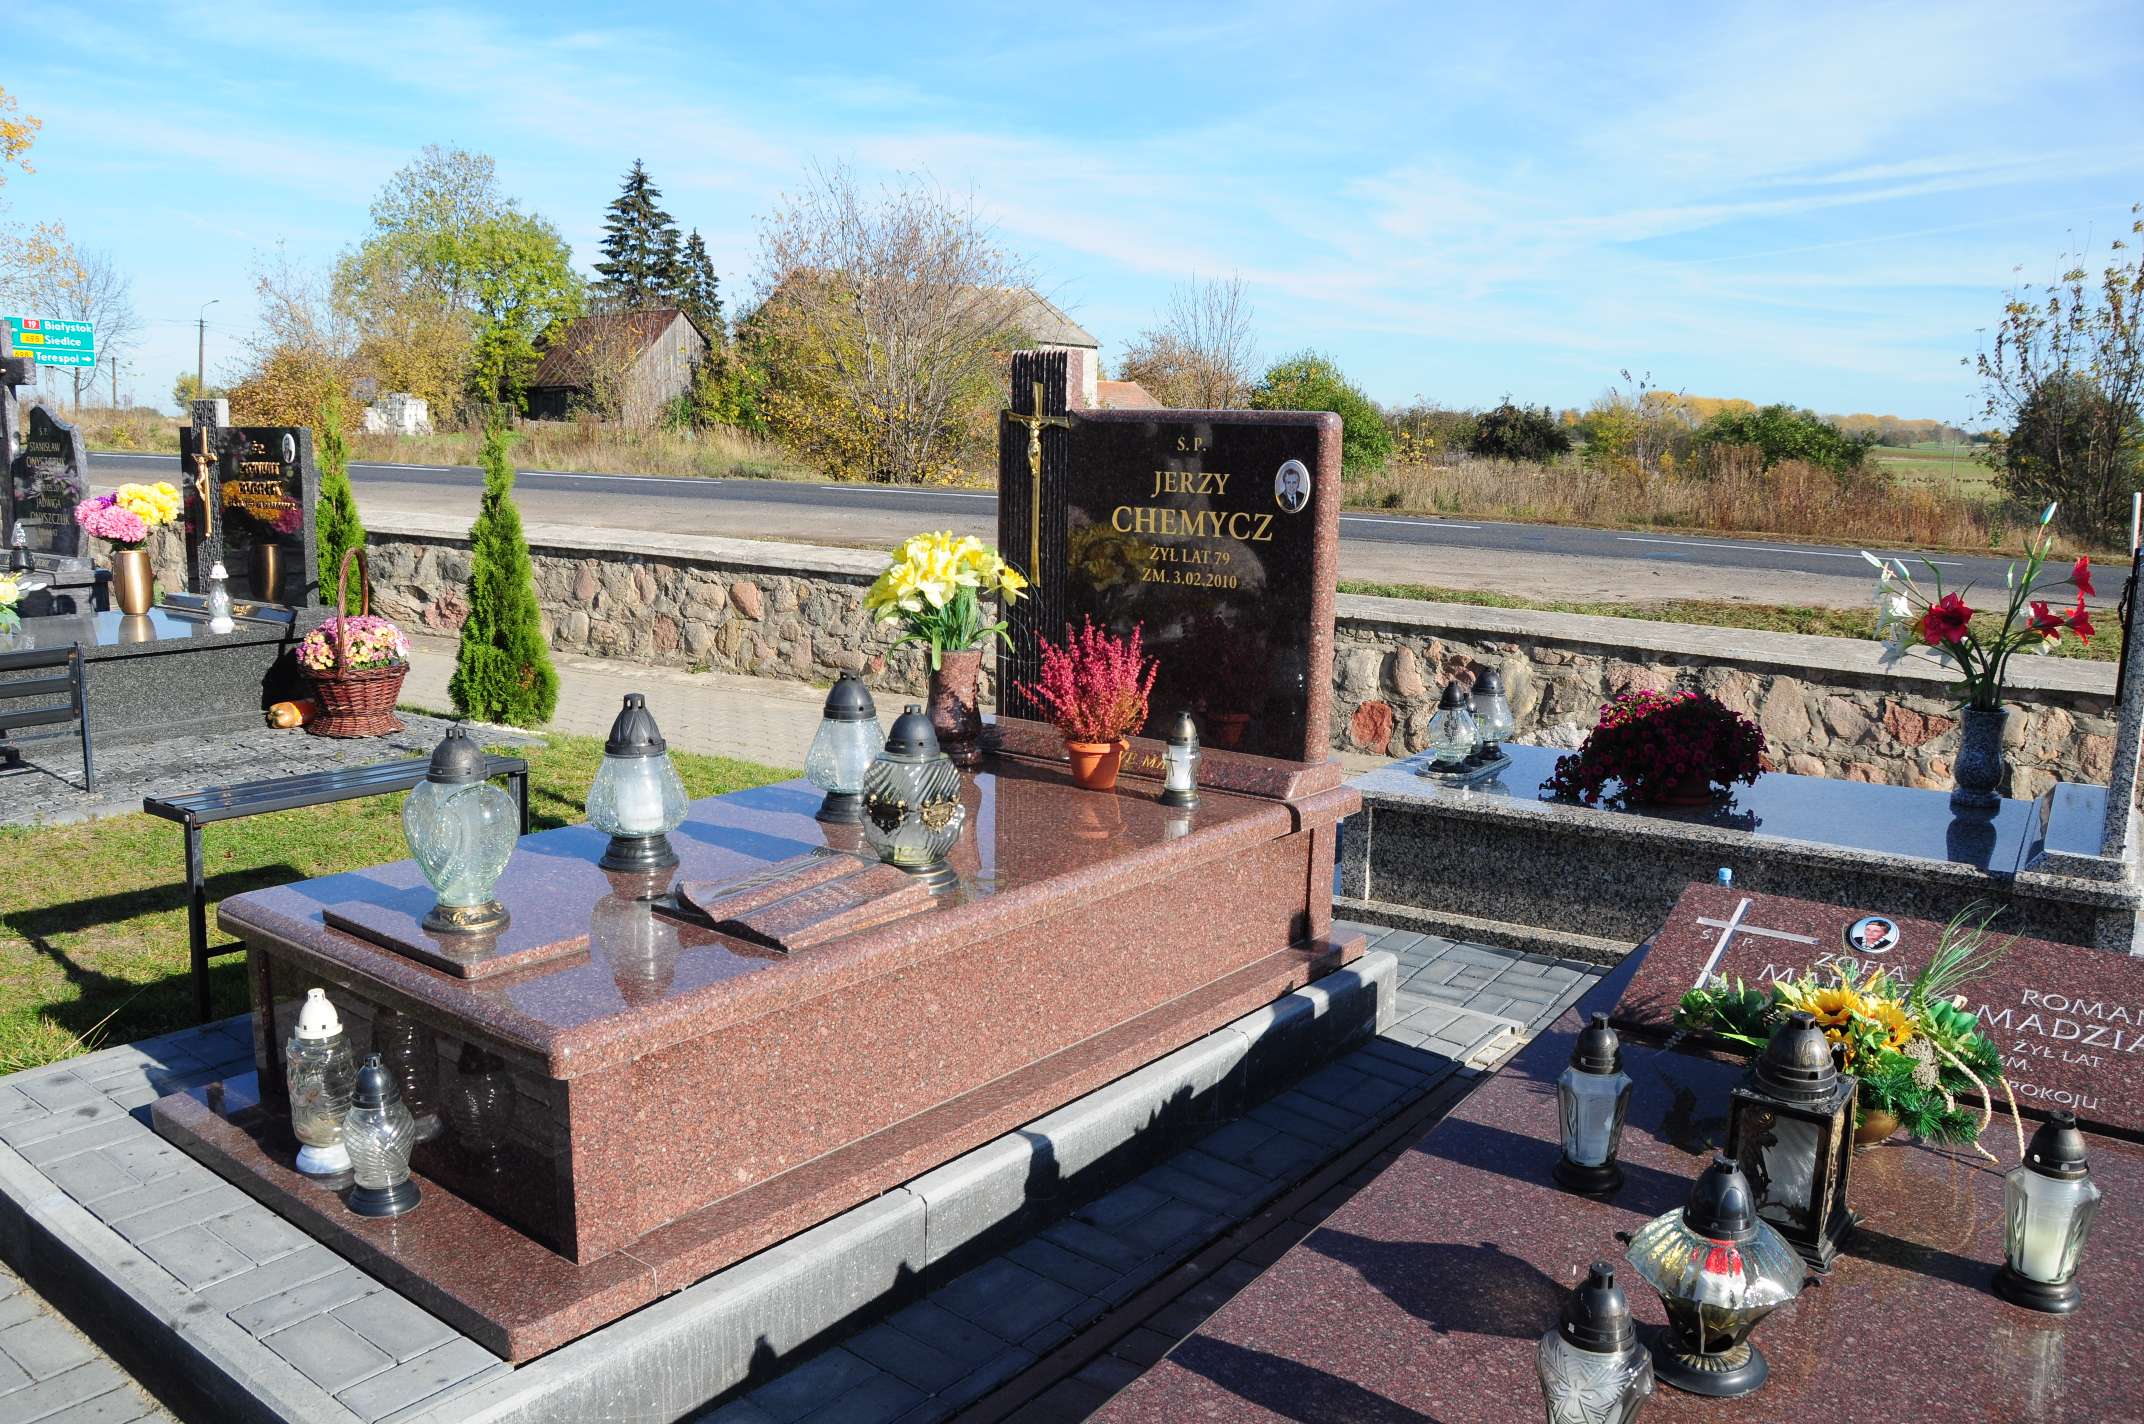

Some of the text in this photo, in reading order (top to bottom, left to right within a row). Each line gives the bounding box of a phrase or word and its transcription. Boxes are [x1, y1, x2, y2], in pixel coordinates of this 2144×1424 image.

[44, 335, 81, 346] Siedlce
[36, 351, 79, 364] Terespol
[1150, 470, 1231, 498] JERZY
[1111, 505, 1274, 542] CHEMYCZ
[1150, 544, 1231, 566] ŻYŁ LAT 79
[1142, 567, 1238, 589] ZM. 3.02.2010
[1813, 951, 1905, 983] ZOFA
[2062, 1050, 2105, 1068] LAT
[2008, 1080, 2099, 1111] POKOJU
